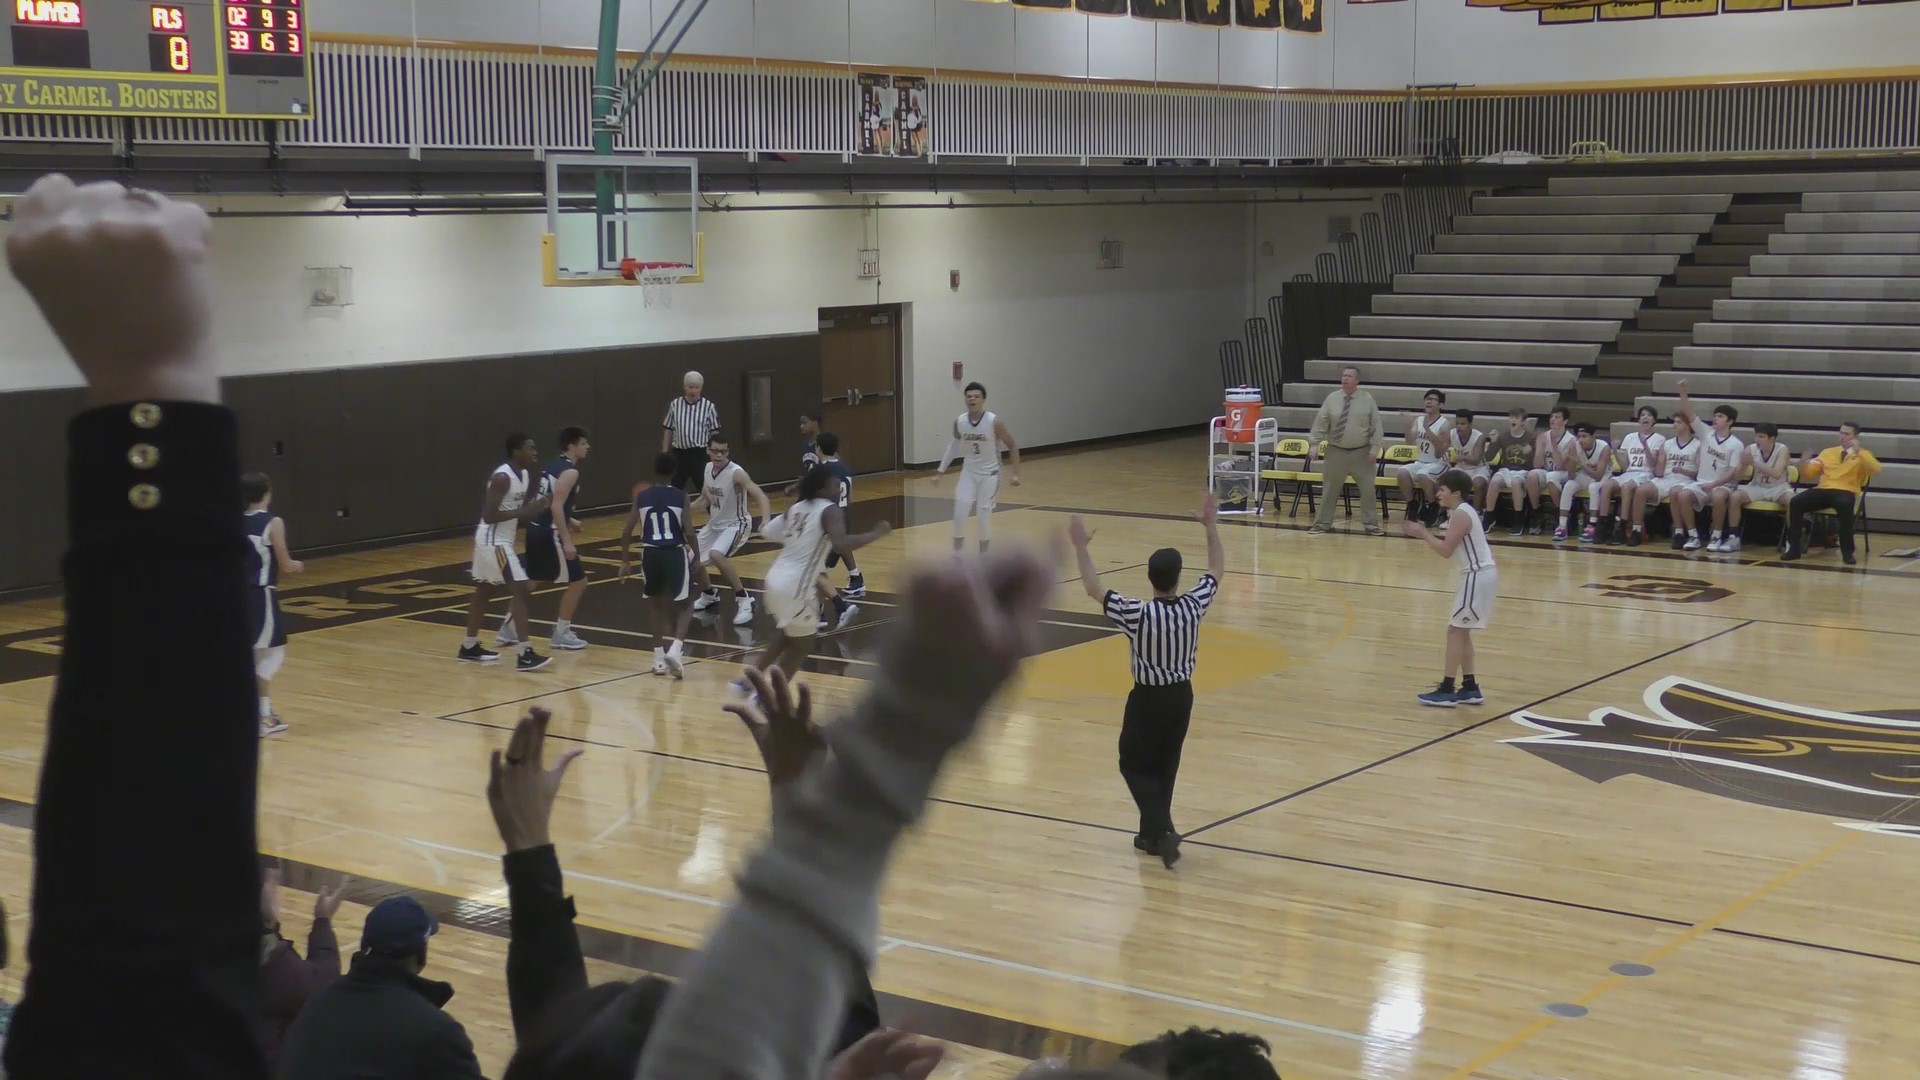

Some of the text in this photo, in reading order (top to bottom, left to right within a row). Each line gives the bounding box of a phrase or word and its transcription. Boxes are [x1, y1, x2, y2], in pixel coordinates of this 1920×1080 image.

[16, 0, 81, 23] PLAYER
[228, 6, 299, 29] 02 9 3
[229, 30, 300, 52] 33 6 3
[169, 36, 189, 70] 8
[23, 79, 112, 106] CARMEL
[118, 83, 217, 110] BOOSTERS
[1231, 409, 1241, 421] G
[1420, 441, 1430, 454] 42
[1631, 456, 1644, 467] 20
[650, 511, 673, 541] 11
